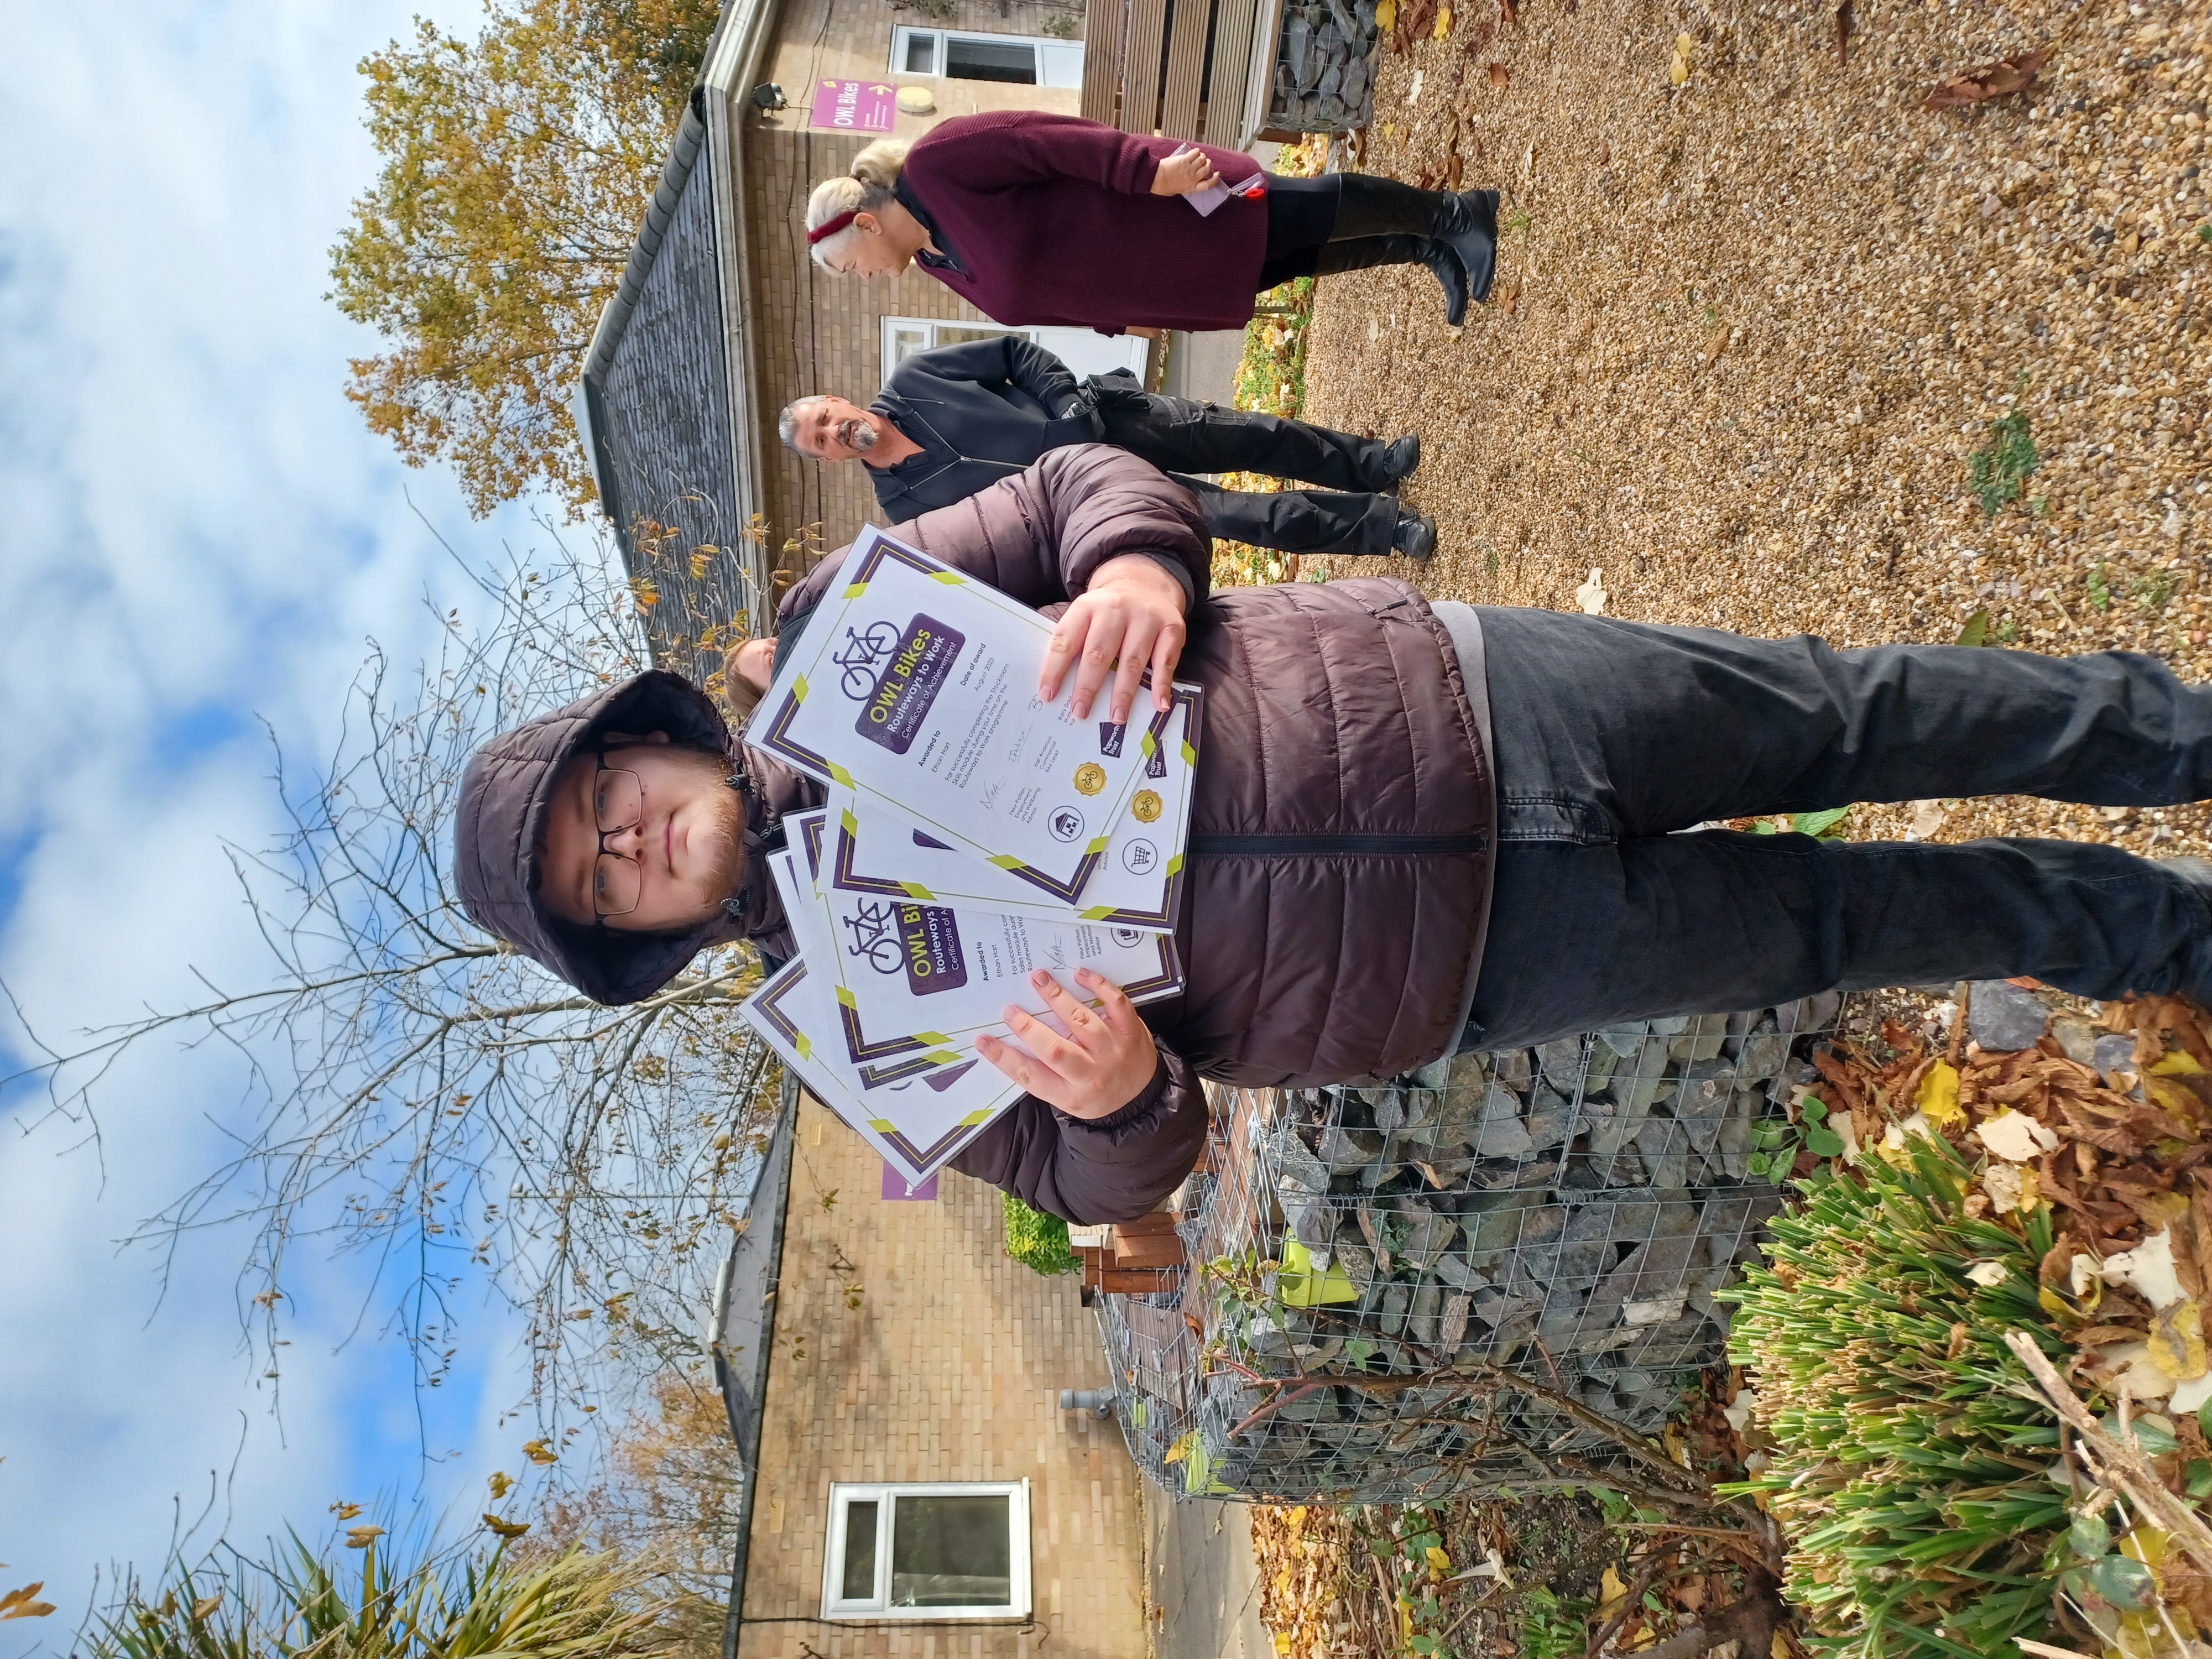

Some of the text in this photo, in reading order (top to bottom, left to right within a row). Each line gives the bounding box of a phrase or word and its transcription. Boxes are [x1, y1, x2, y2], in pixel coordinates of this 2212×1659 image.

[833, 82, 859, 125] OWL Bikes
[869, 629, 931, 723] OWL Bikes
[959, 670, 972, 686] Date
[973, 643, 986, 662] award
[974, 657, 995, 691] August 2023
[886, 635, 945, 732] Routeways to Work
[901, 641, 956, 738] Certificate of Achievement
[944, 663, 1009, 781] For successfully completing the Stockroom
[951, 684, 1008, 785] Skills module during your time on the
[1102, 725, 1120, 753] Papworth
[918, 737, 937, 766] Awarded
[931, 742, 951, 773] Ethan Hart
[958, 757, 979, 789] Routeways
[979, 734, 990, 748] Work
[988, 700, 1009, 734] programme
[1039, 735, 1053, 758] Anderson
[1108, 740, 1119, 754] Trust
[1044, 763, 1053, 773] Bike
[1020, 810, 1029, 821] and
[1026, 806, 1037, 824] Advisor
[900, 902, 931, 976] OWL Bi
[926, 911, 946, 973] Routeways
[945, 927, 959, 970] Certificate
[1004, 927, 1016, 964] successfully
[1013, 931, 1022, 956] module
[1021, 936, 1033, 971] Routeways
[977, 950, 989, 980] Awarded
[990, 944, 1003, 977] Ethan Hart
